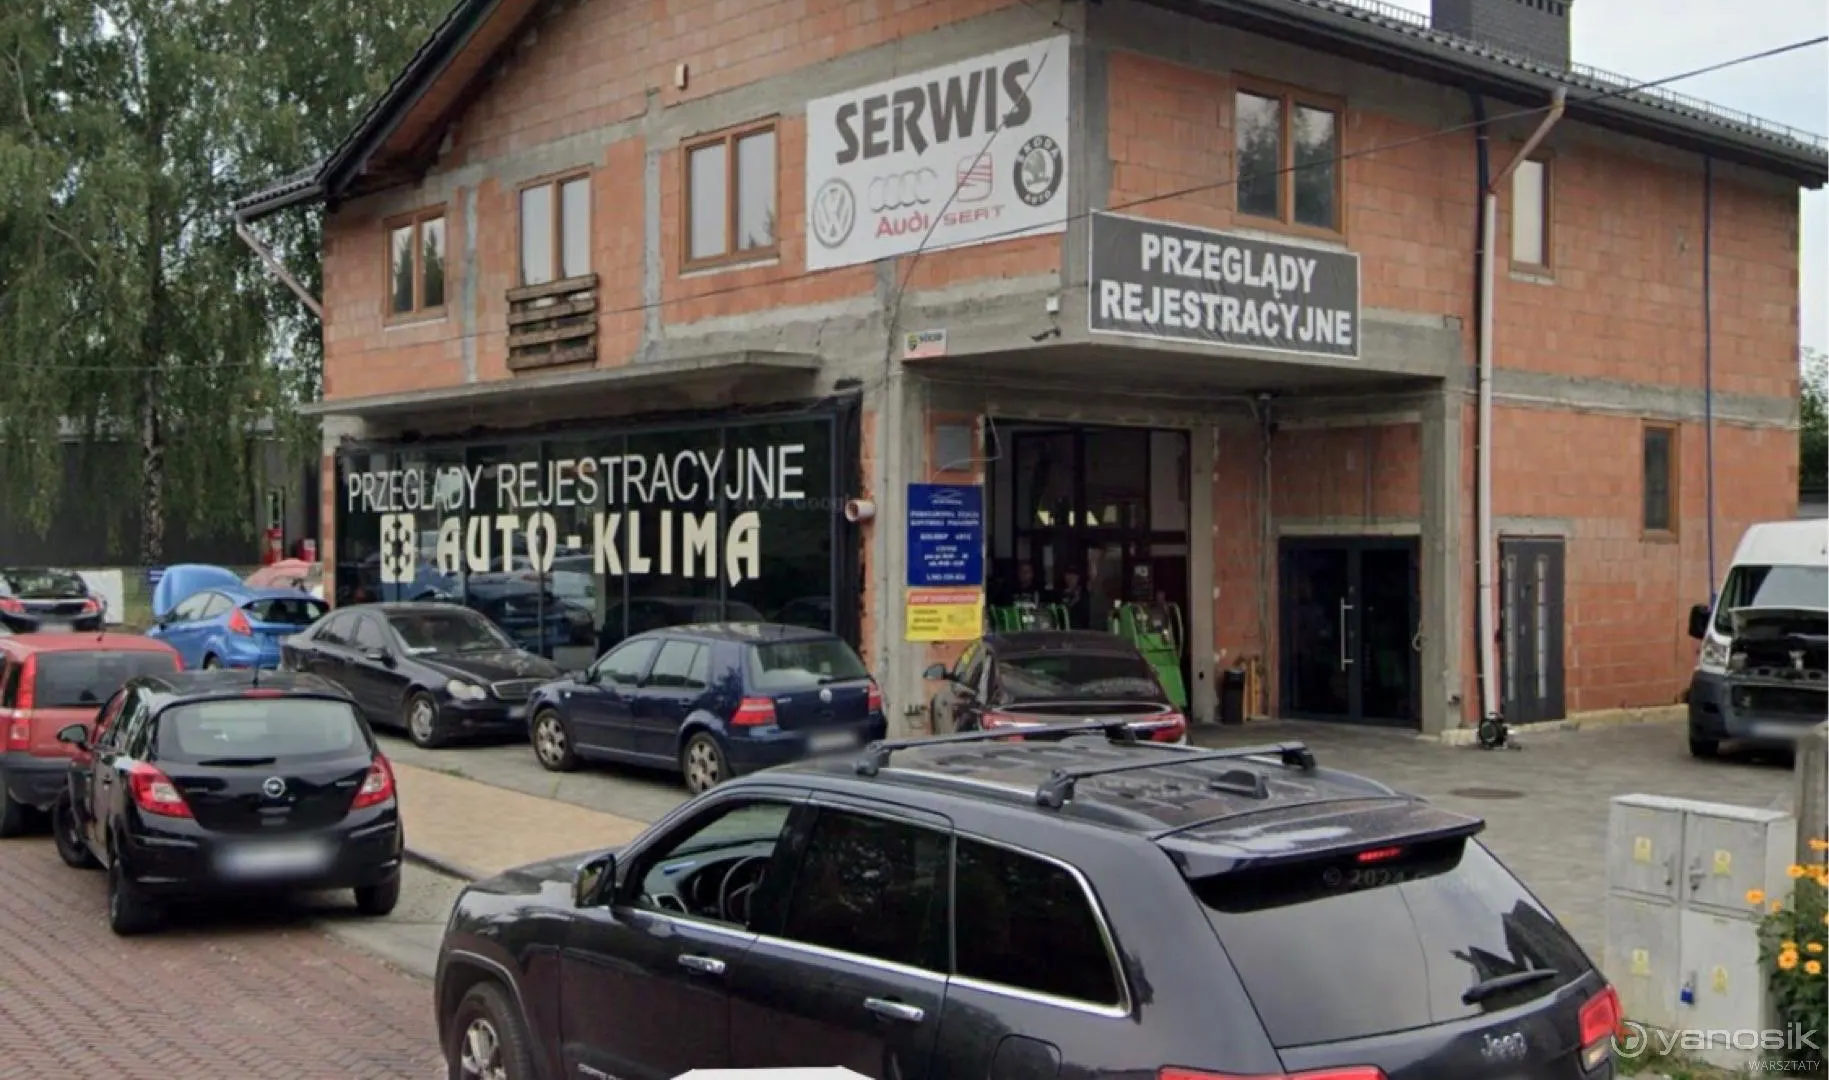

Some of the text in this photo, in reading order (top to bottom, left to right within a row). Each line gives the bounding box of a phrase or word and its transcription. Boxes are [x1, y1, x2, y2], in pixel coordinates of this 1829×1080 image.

[835, 58, 1032, 165] SERWIS
[942, 204, 1005, 227] SEAT
[1140, 232, 1317, 299] PRZEGLĄDY
[1099, 278, 1352, 345] REJESTRACYJNE
[496, 443, 805, 509] REJESTRACYJNE
